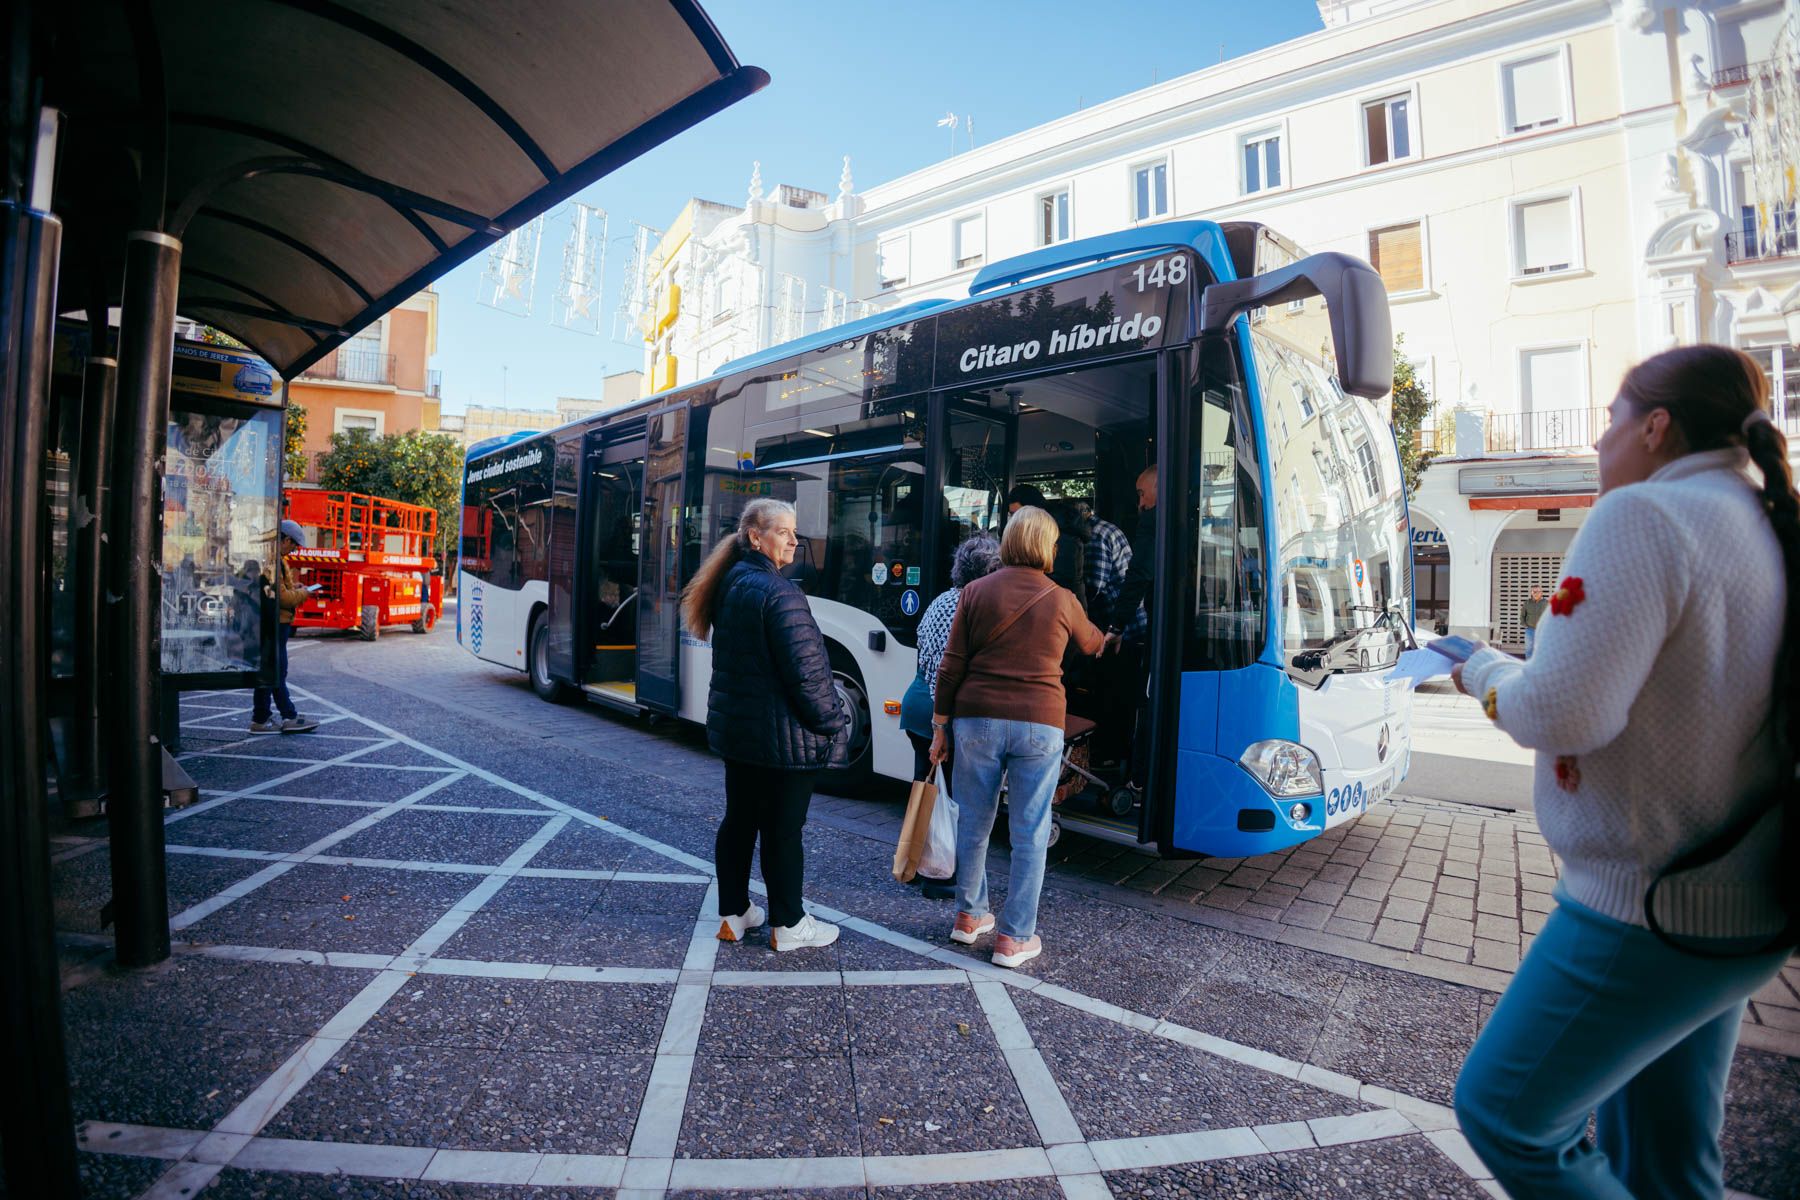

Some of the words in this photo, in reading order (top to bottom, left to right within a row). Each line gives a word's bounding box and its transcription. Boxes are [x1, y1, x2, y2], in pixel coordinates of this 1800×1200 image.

[1132, 255, 1187, 292] 148
[199, 350, 208, 358] DE
[210, 352, 229, 361] JEREZ
[959, 339, 1040, 373] Citaro
[1048, 312, 1162, 355] híbrido
[467, 470, 482, 484] Jerez
[483, 460, 504, 479] ciudad
[505, 448, 542, 473] sostenible
[299, 549, 340, 558] ALQUILERES
